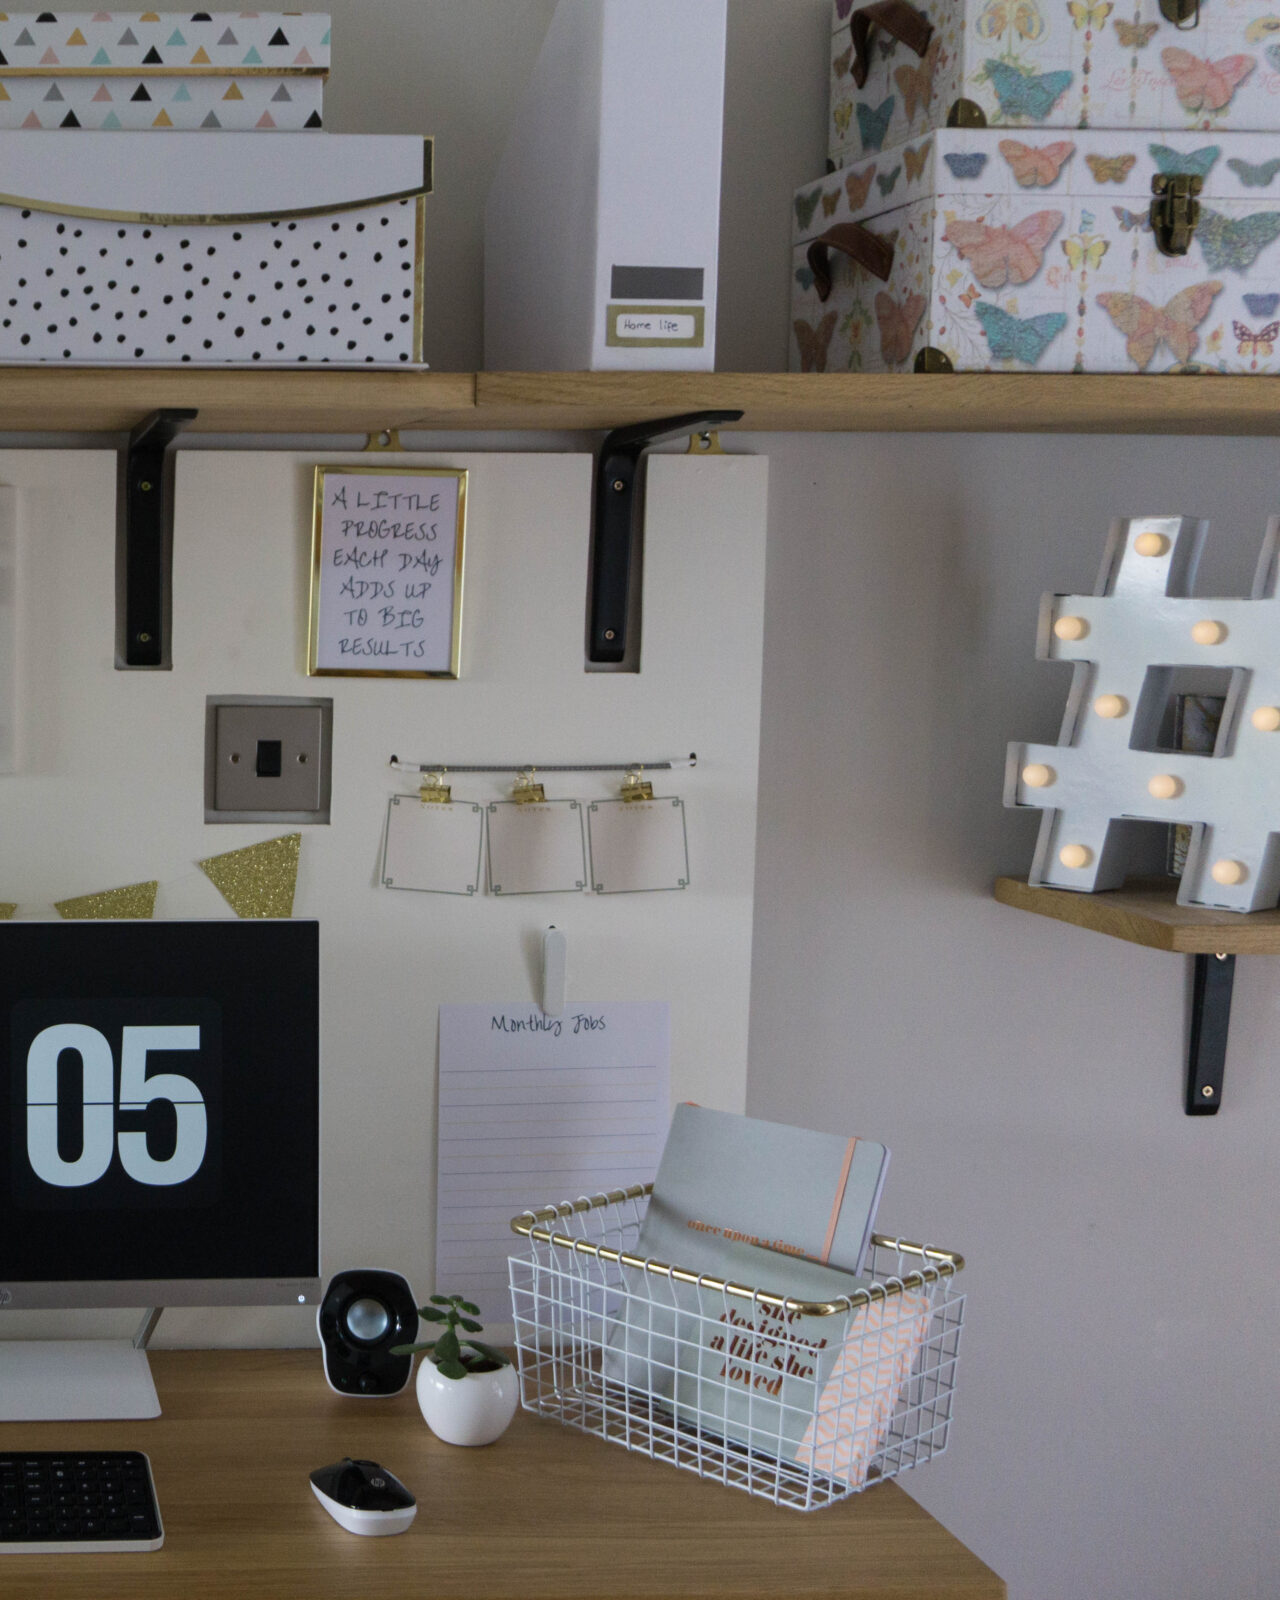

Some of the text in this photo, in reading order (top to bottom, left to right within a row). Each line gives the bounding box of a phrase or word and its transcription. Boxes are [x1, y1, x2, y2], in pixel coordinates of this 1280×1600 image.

[623, 319, 679, 333] Home life
[331, 485, 441, 512] A LITTLE
[341, 519, 438, 541] PROGRESS
[333, 546, 389, 569] EACH
[339, 575, 432, 600] ADDS UP
[343, 605, 424, 629] TO BIG
[338, 637, 426, 658] RESULTS
[491, 1011, 606, 1037] Monthly Jobs
[26, 1023, 208, 1187] 05
[687, 1219, 722, 1236] once
[723, 1227, 760, 1246] upon
[773, 1239, 805, 1256] time
[710, 1334, 814, 1378] a life she
[720, 1358, 784, 1397] loved
